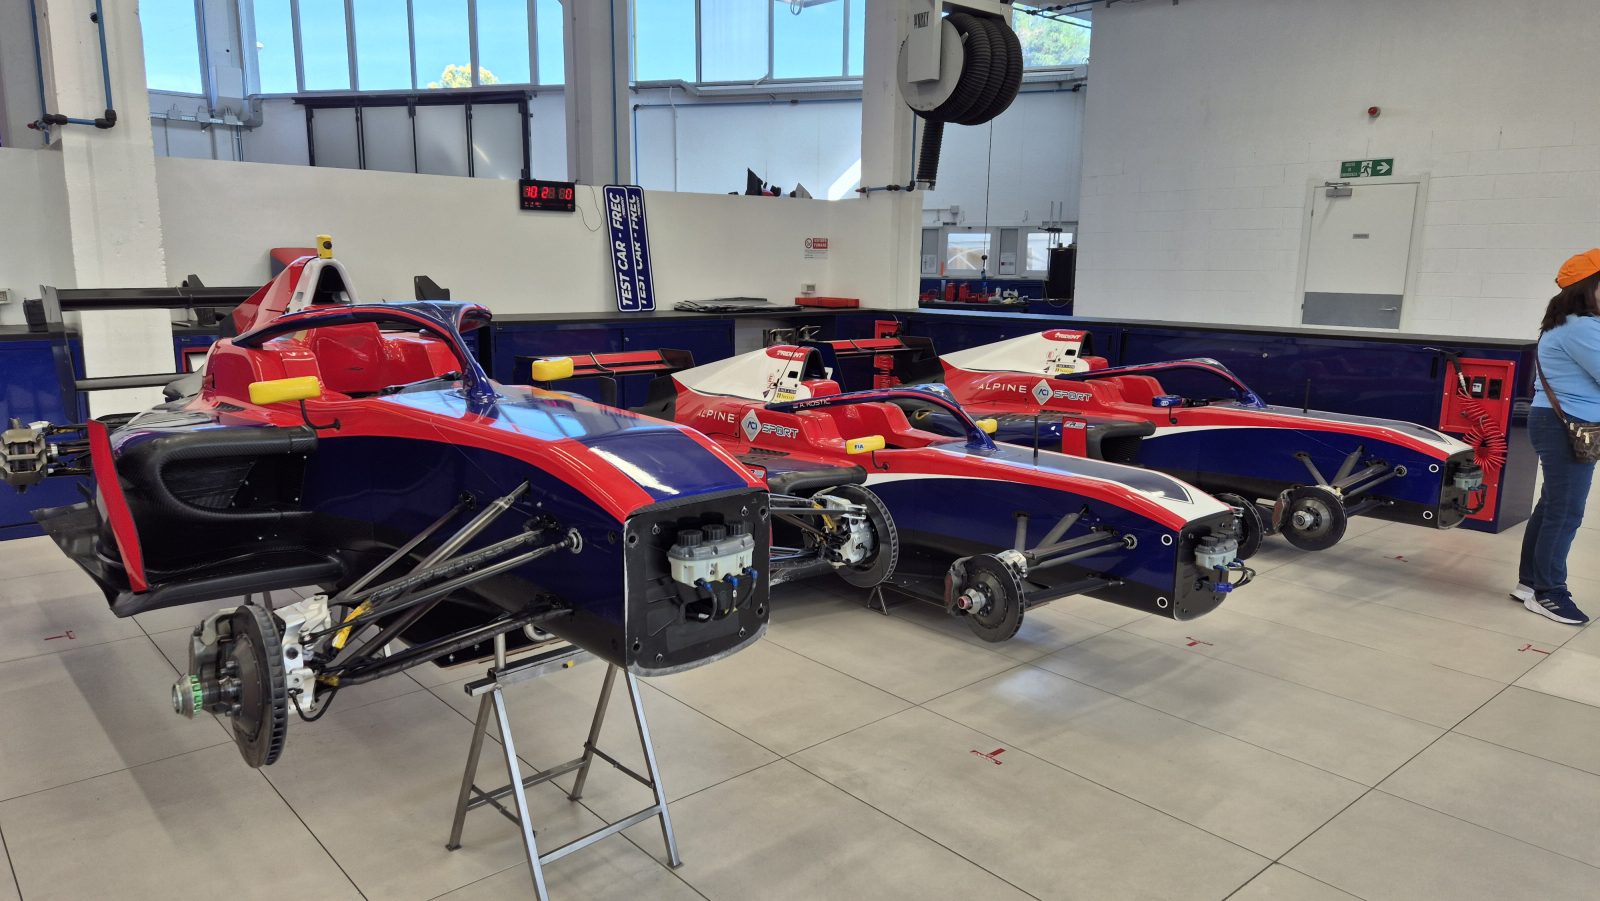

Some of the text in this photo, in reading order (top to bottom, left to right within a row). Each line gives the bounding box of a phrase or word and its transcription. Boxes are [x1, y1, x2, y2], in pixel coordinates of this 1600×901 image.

[609, 192, 624, 230] FREC
[615, 241, 628, 270] CAR
[619, 272, 632, 305] TEST
[776, 350, 804, 358] TRIDENT
[977, 383, 1027, 394] ALPINE
[1053, 389, 1092, 402] SPORT
[696, 408, 735, 424] ALPINE
[761, 422, 799, 439] SPORT
